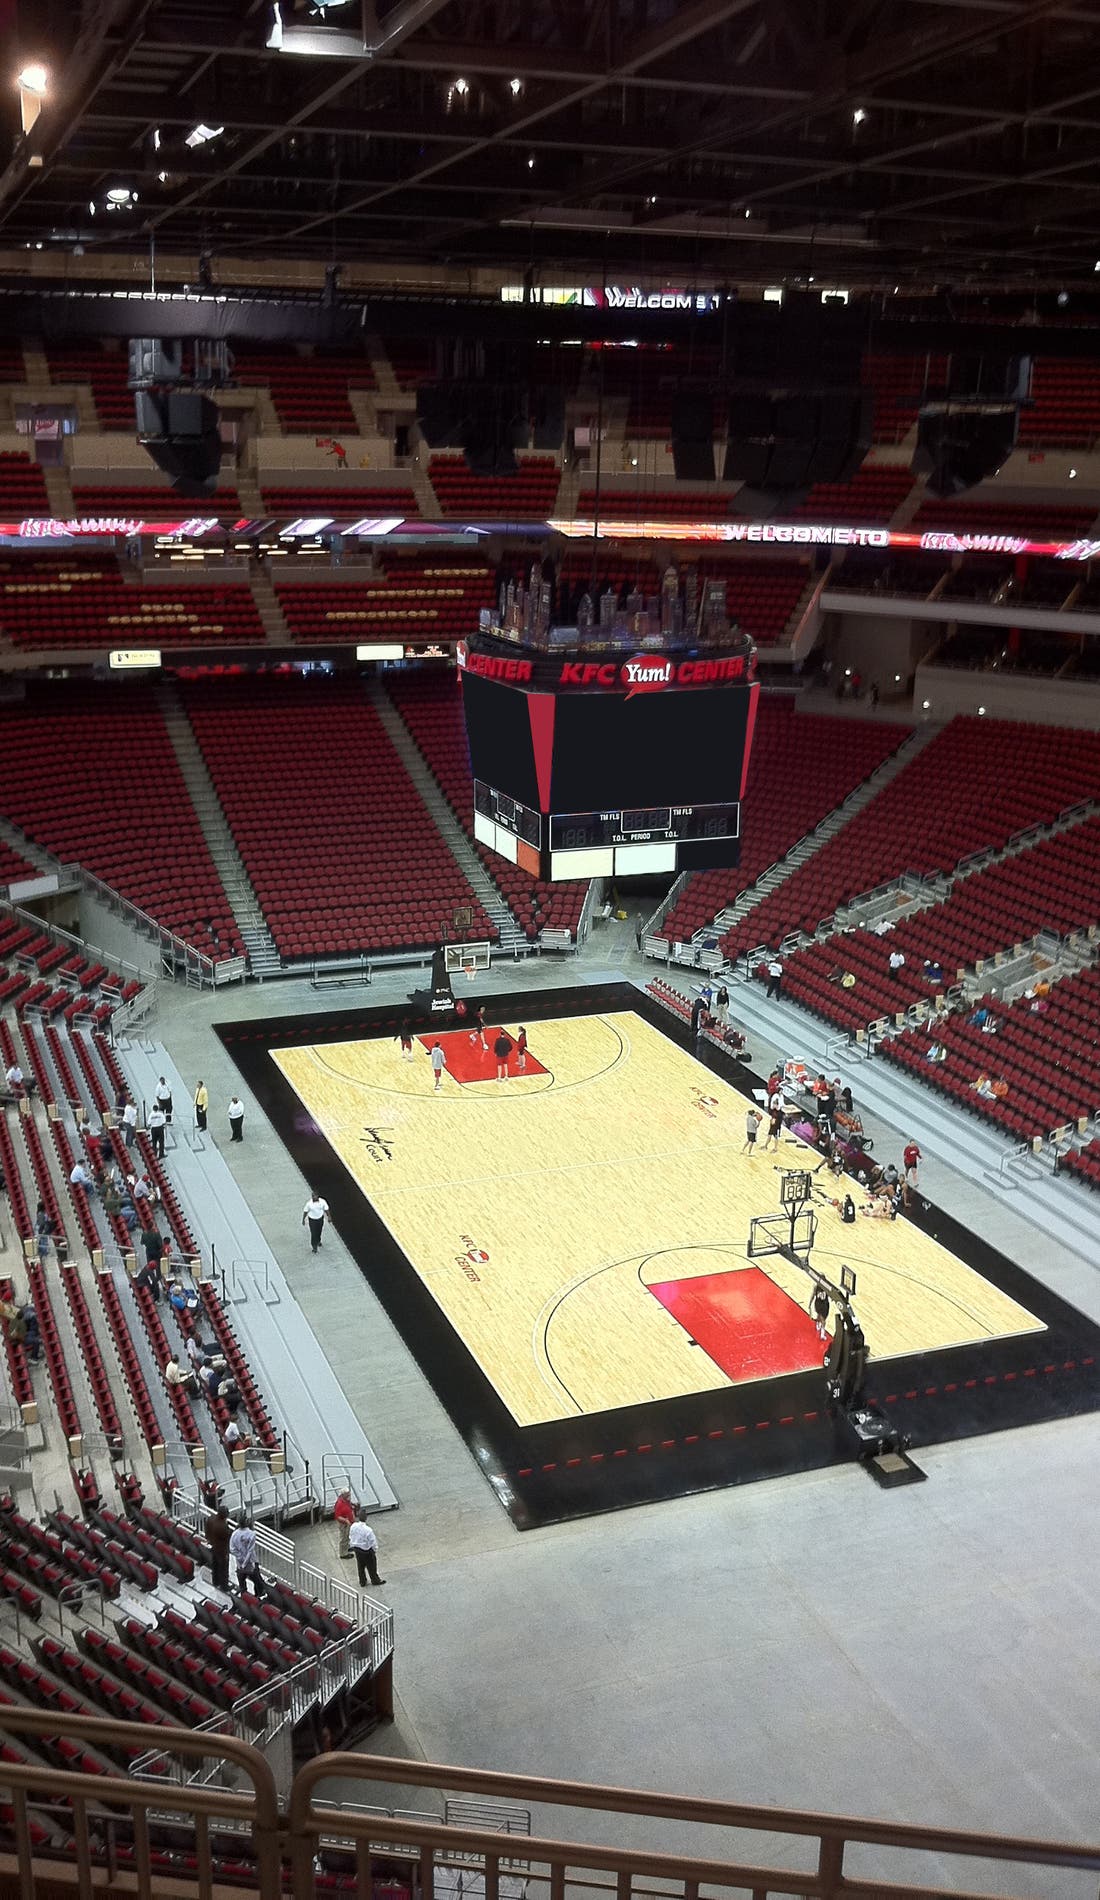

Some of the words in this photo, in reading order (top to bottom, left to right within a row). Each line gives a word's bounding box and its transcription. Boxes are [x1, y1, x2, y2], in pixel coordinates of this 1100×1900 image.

[723, 525, 850, 545] WELCOME
[855, 529, 890, 547] TO
[468, 653, 533, 682] CENTER
[560, 662, 617, 685] KFC
[626, 662, 672, 683] Yum!
[677, 656, 744, 685] CENTER
[630, 832, 651, 841] PERIOD
